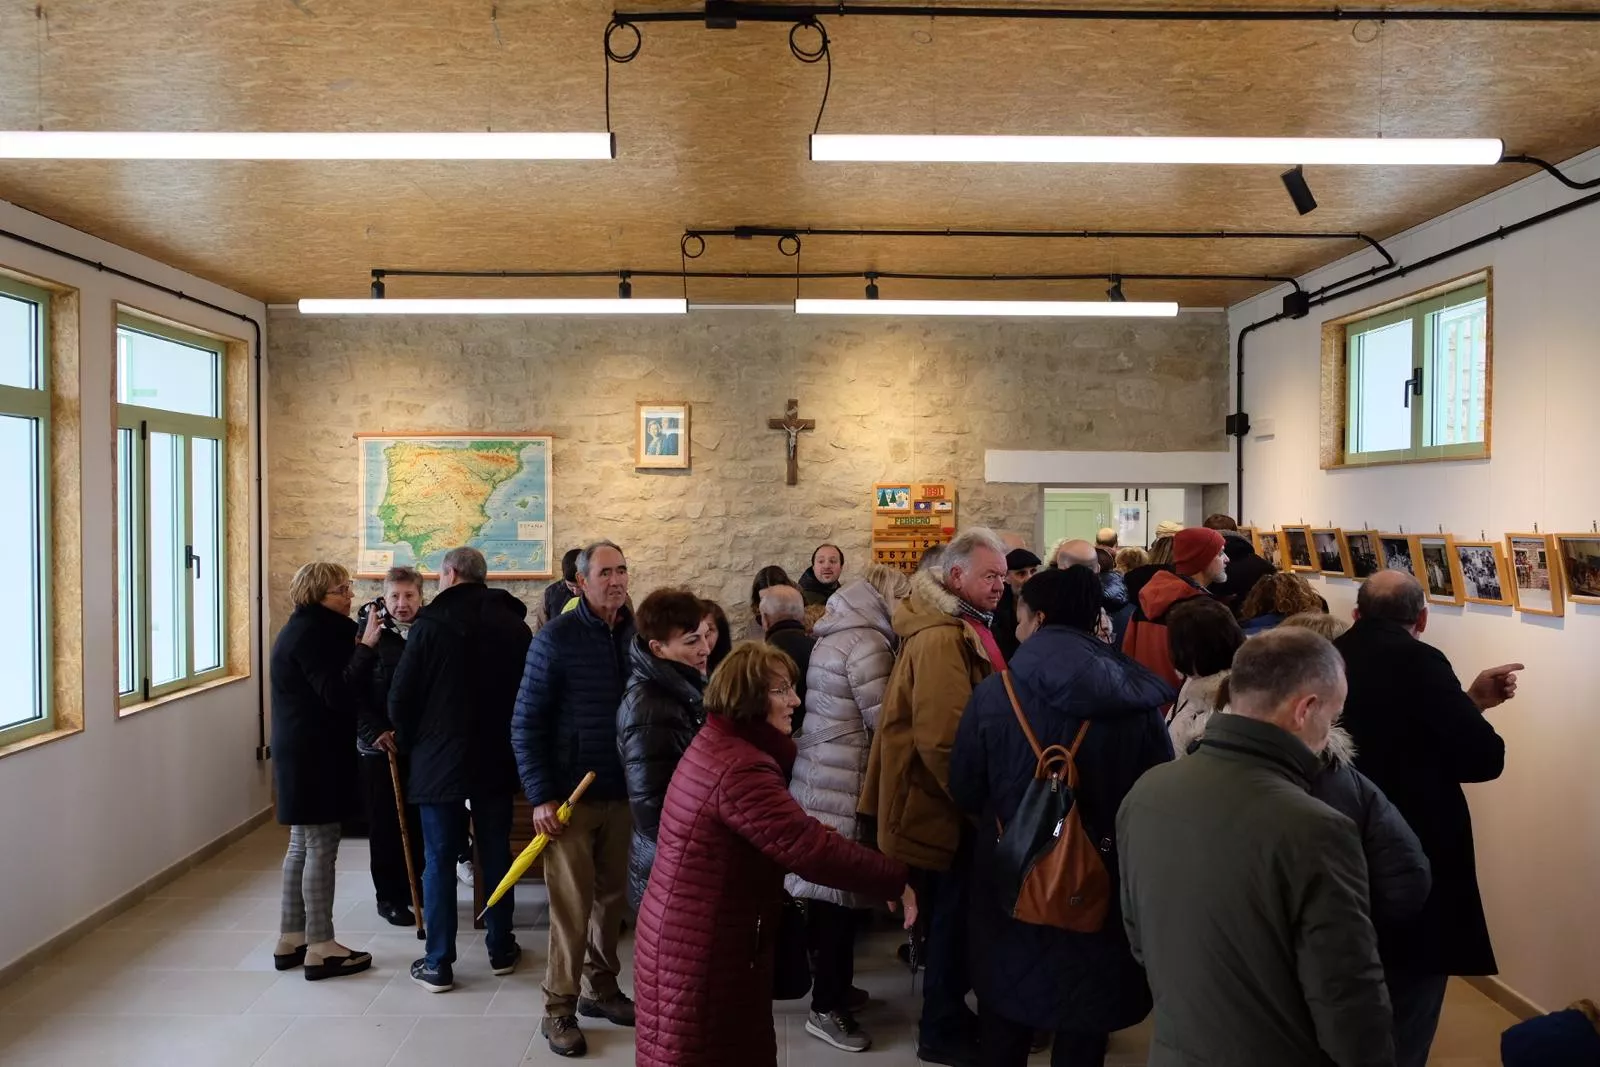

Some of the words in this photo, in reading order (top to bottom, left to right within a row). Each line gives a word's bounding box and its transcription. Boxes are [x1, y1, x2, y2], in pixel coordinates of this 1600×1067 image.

[895, 516, 930, 525] FEBRERO
[923, 540, 929, 548] 2
[878, 551, 884, 559] 5
[889, 551, 895, 559] 6
[900, 551, 906, 559] 7
[911, 551, 917, 559] 8
[899, 561, 906, 569] 14
